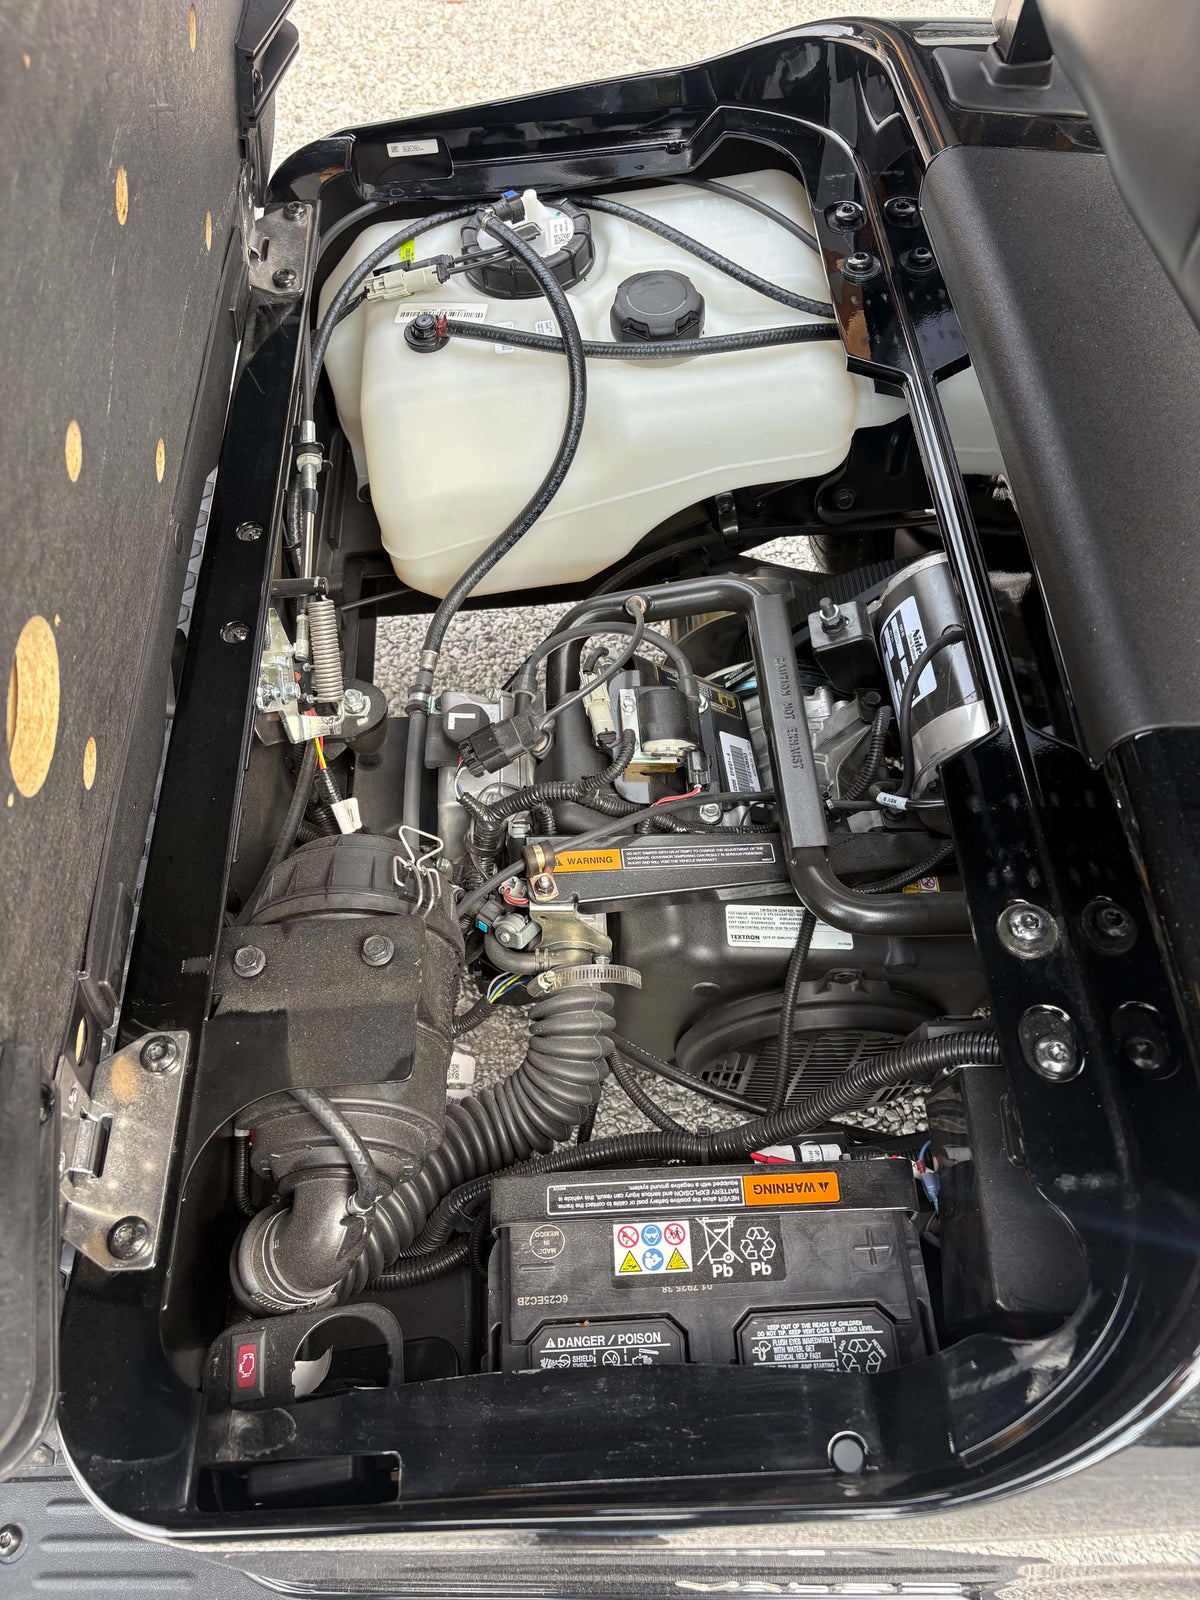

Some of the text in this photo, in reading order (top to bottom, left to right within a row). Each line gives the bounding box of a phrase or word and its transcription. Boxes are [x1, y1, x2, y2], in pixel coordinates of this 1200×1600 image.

[776, 656, 804, 769] CAUTION HOT EXHAUST
[567, 856, 613, 866] WARNING
[753, 1182, 816, 1195] WARNING
[712, 1264, 734, 1278] Pb
[750, 1262, 772, 1276] Pb
[517, 1294, 568, 1306] 6C25EC2B
[557, 1332, 661, 1348] DANGER / POISON
